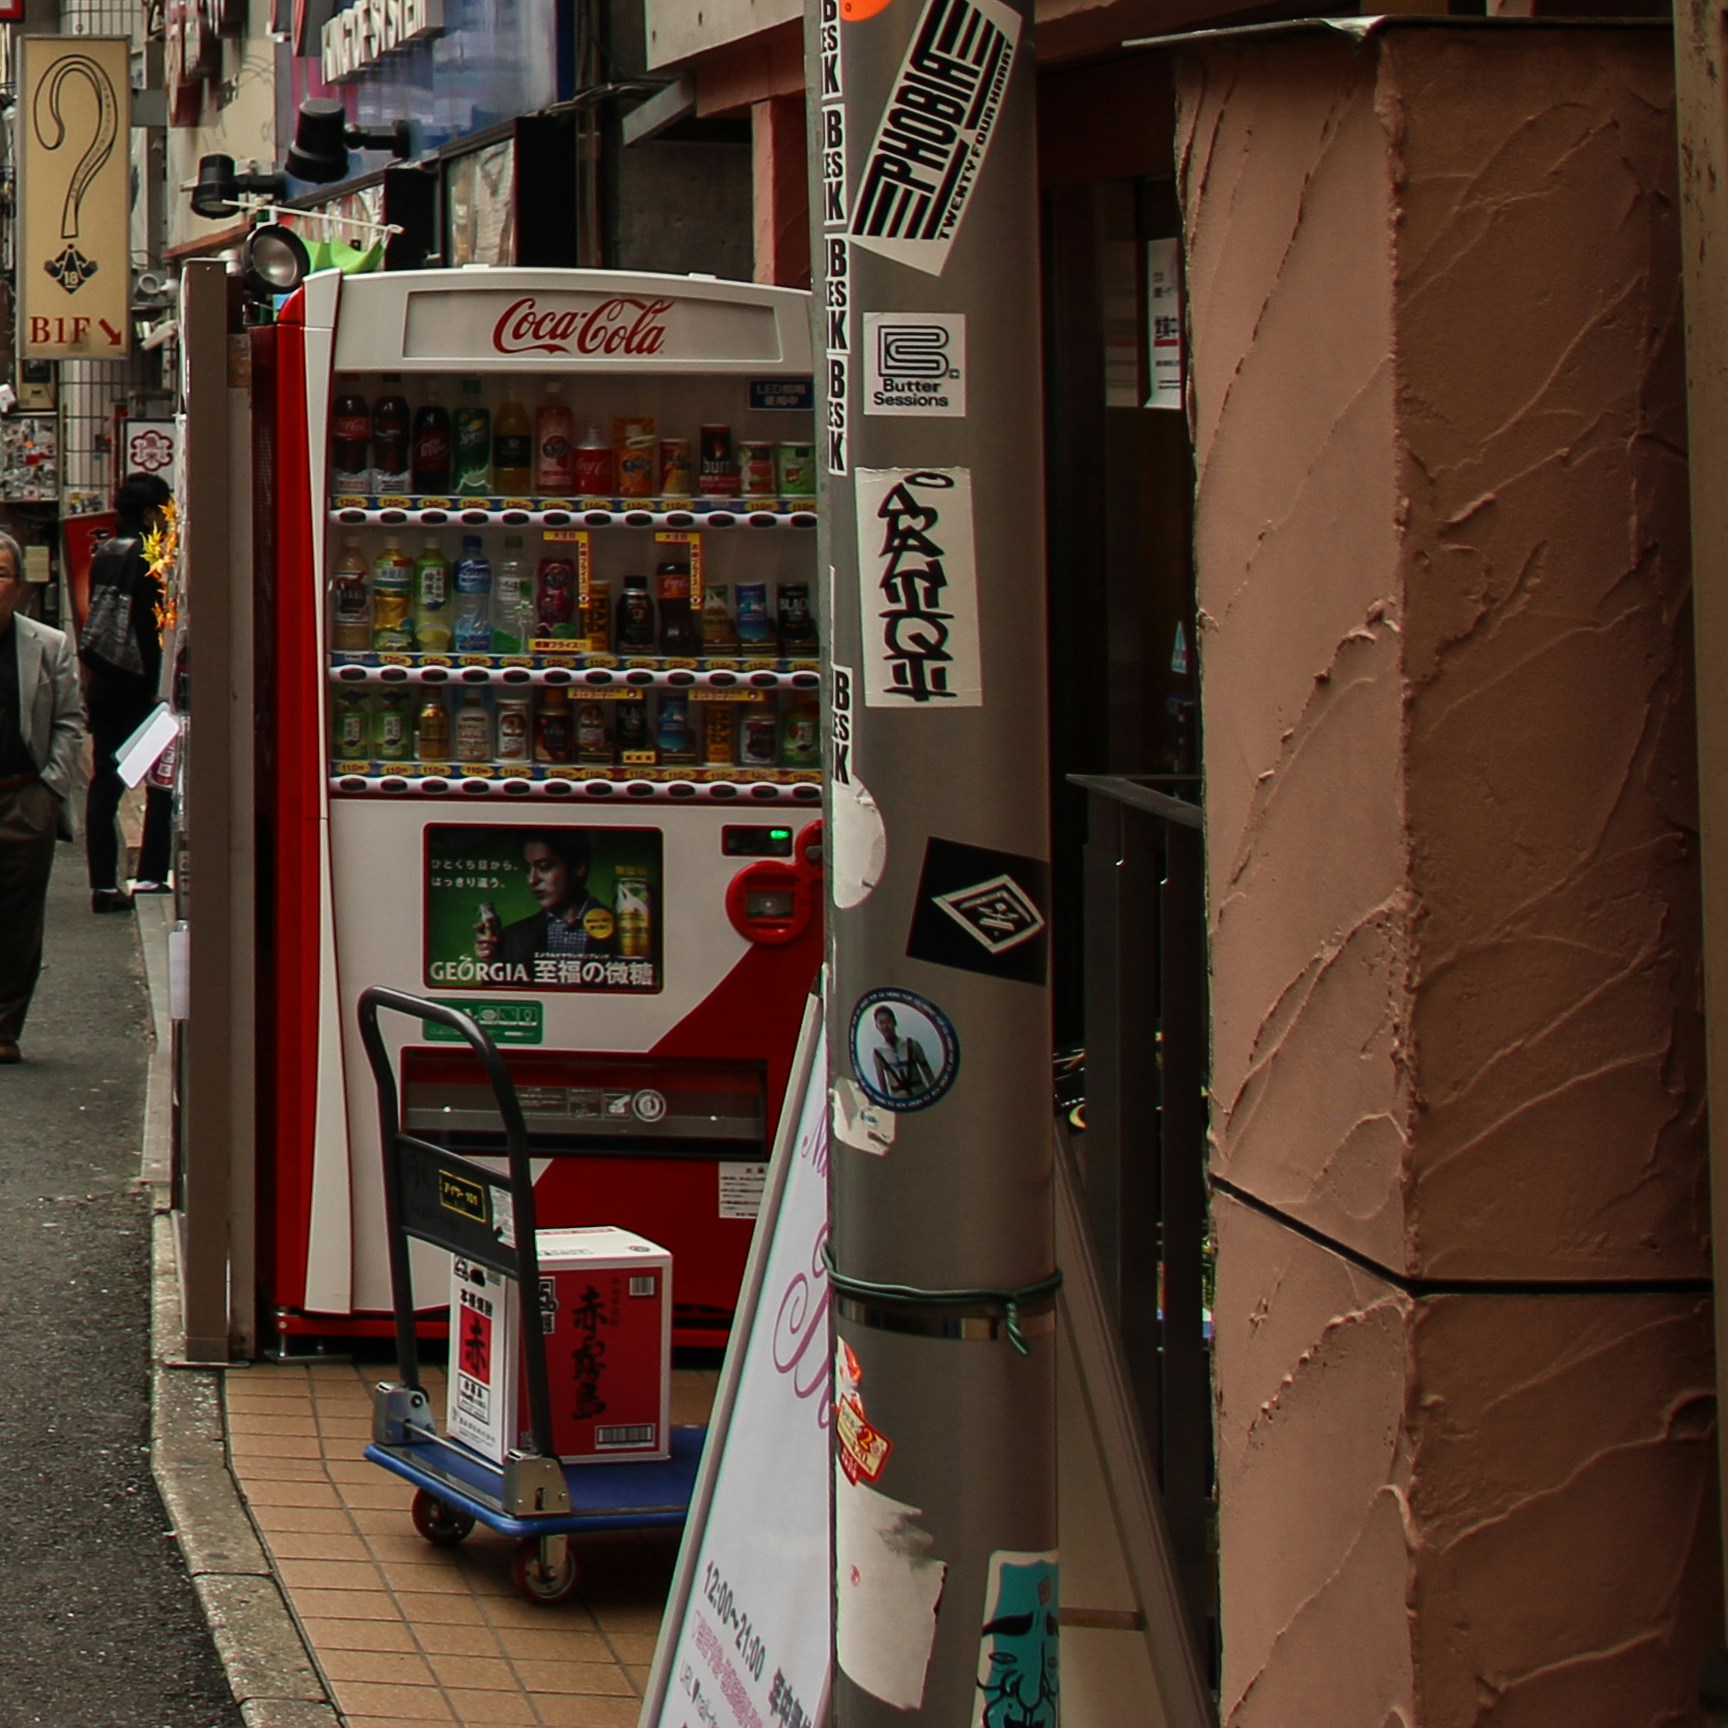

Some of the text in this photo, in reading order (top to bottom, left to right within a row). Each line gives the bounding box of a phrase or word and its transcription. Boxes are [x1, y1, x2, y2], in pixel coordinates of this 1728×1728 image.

[878, 49, 981, 194] PHOBIA
[937, 158, 977, 241] TWENTY
[970, 104, 996, 157] FOUR
[30, 317, 91, 344] B1F
[493, 297, 675, 355] Coca-Cola
[873, 391, 950, 408] Sessions
[882, 377, 942, 395] Butter
[429, 956, 530, 982] GEORGIA
[533, 958, 654, 985] 至福の微糖
